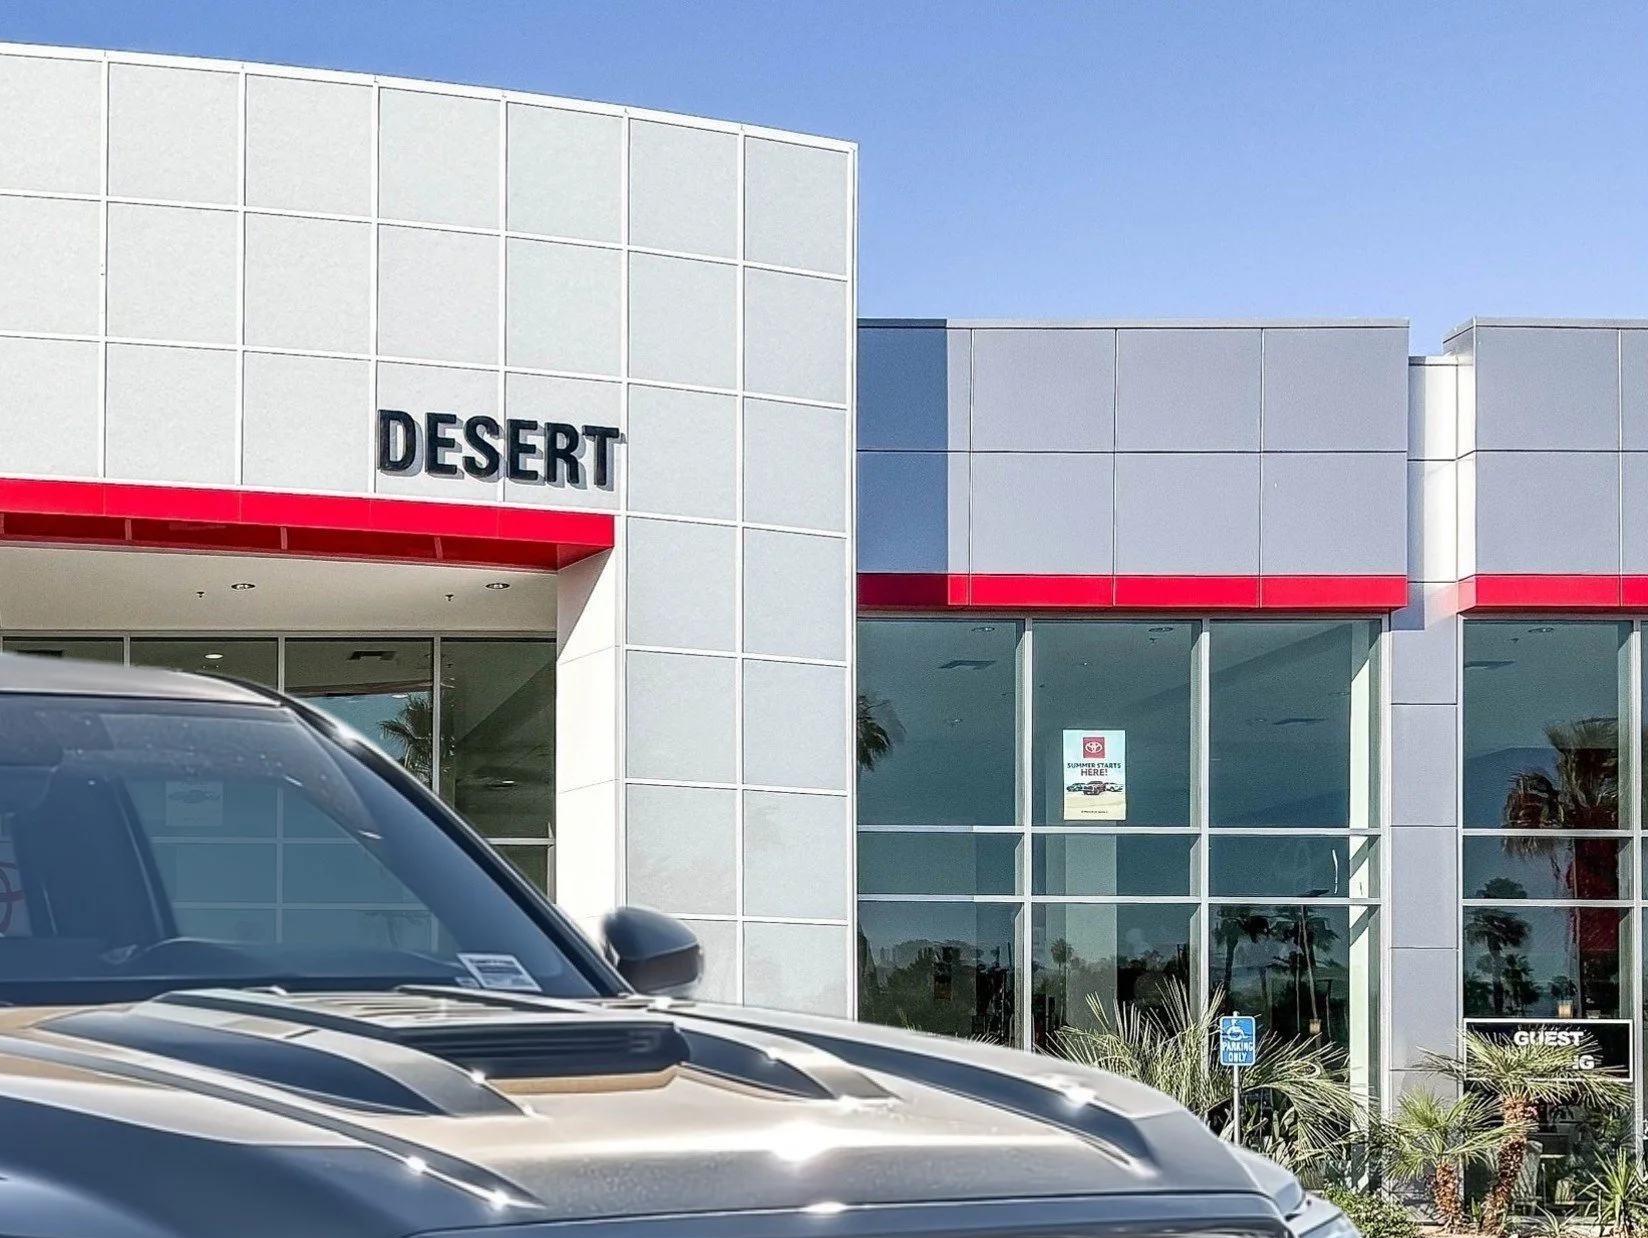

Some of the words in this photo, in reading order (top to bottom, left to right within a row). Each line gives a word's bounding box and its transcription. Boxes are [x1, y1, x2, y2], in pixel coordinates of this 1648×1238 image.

[377, 409, 621, 487] DESERT
[1080, 768, 1108, 776] HERE!
[1513, 1031, 1584, 1047] GUEST
[1222, 1041, 1253, 1052] PARKING
[1228, 1052, 1247, 1062] ONLY
